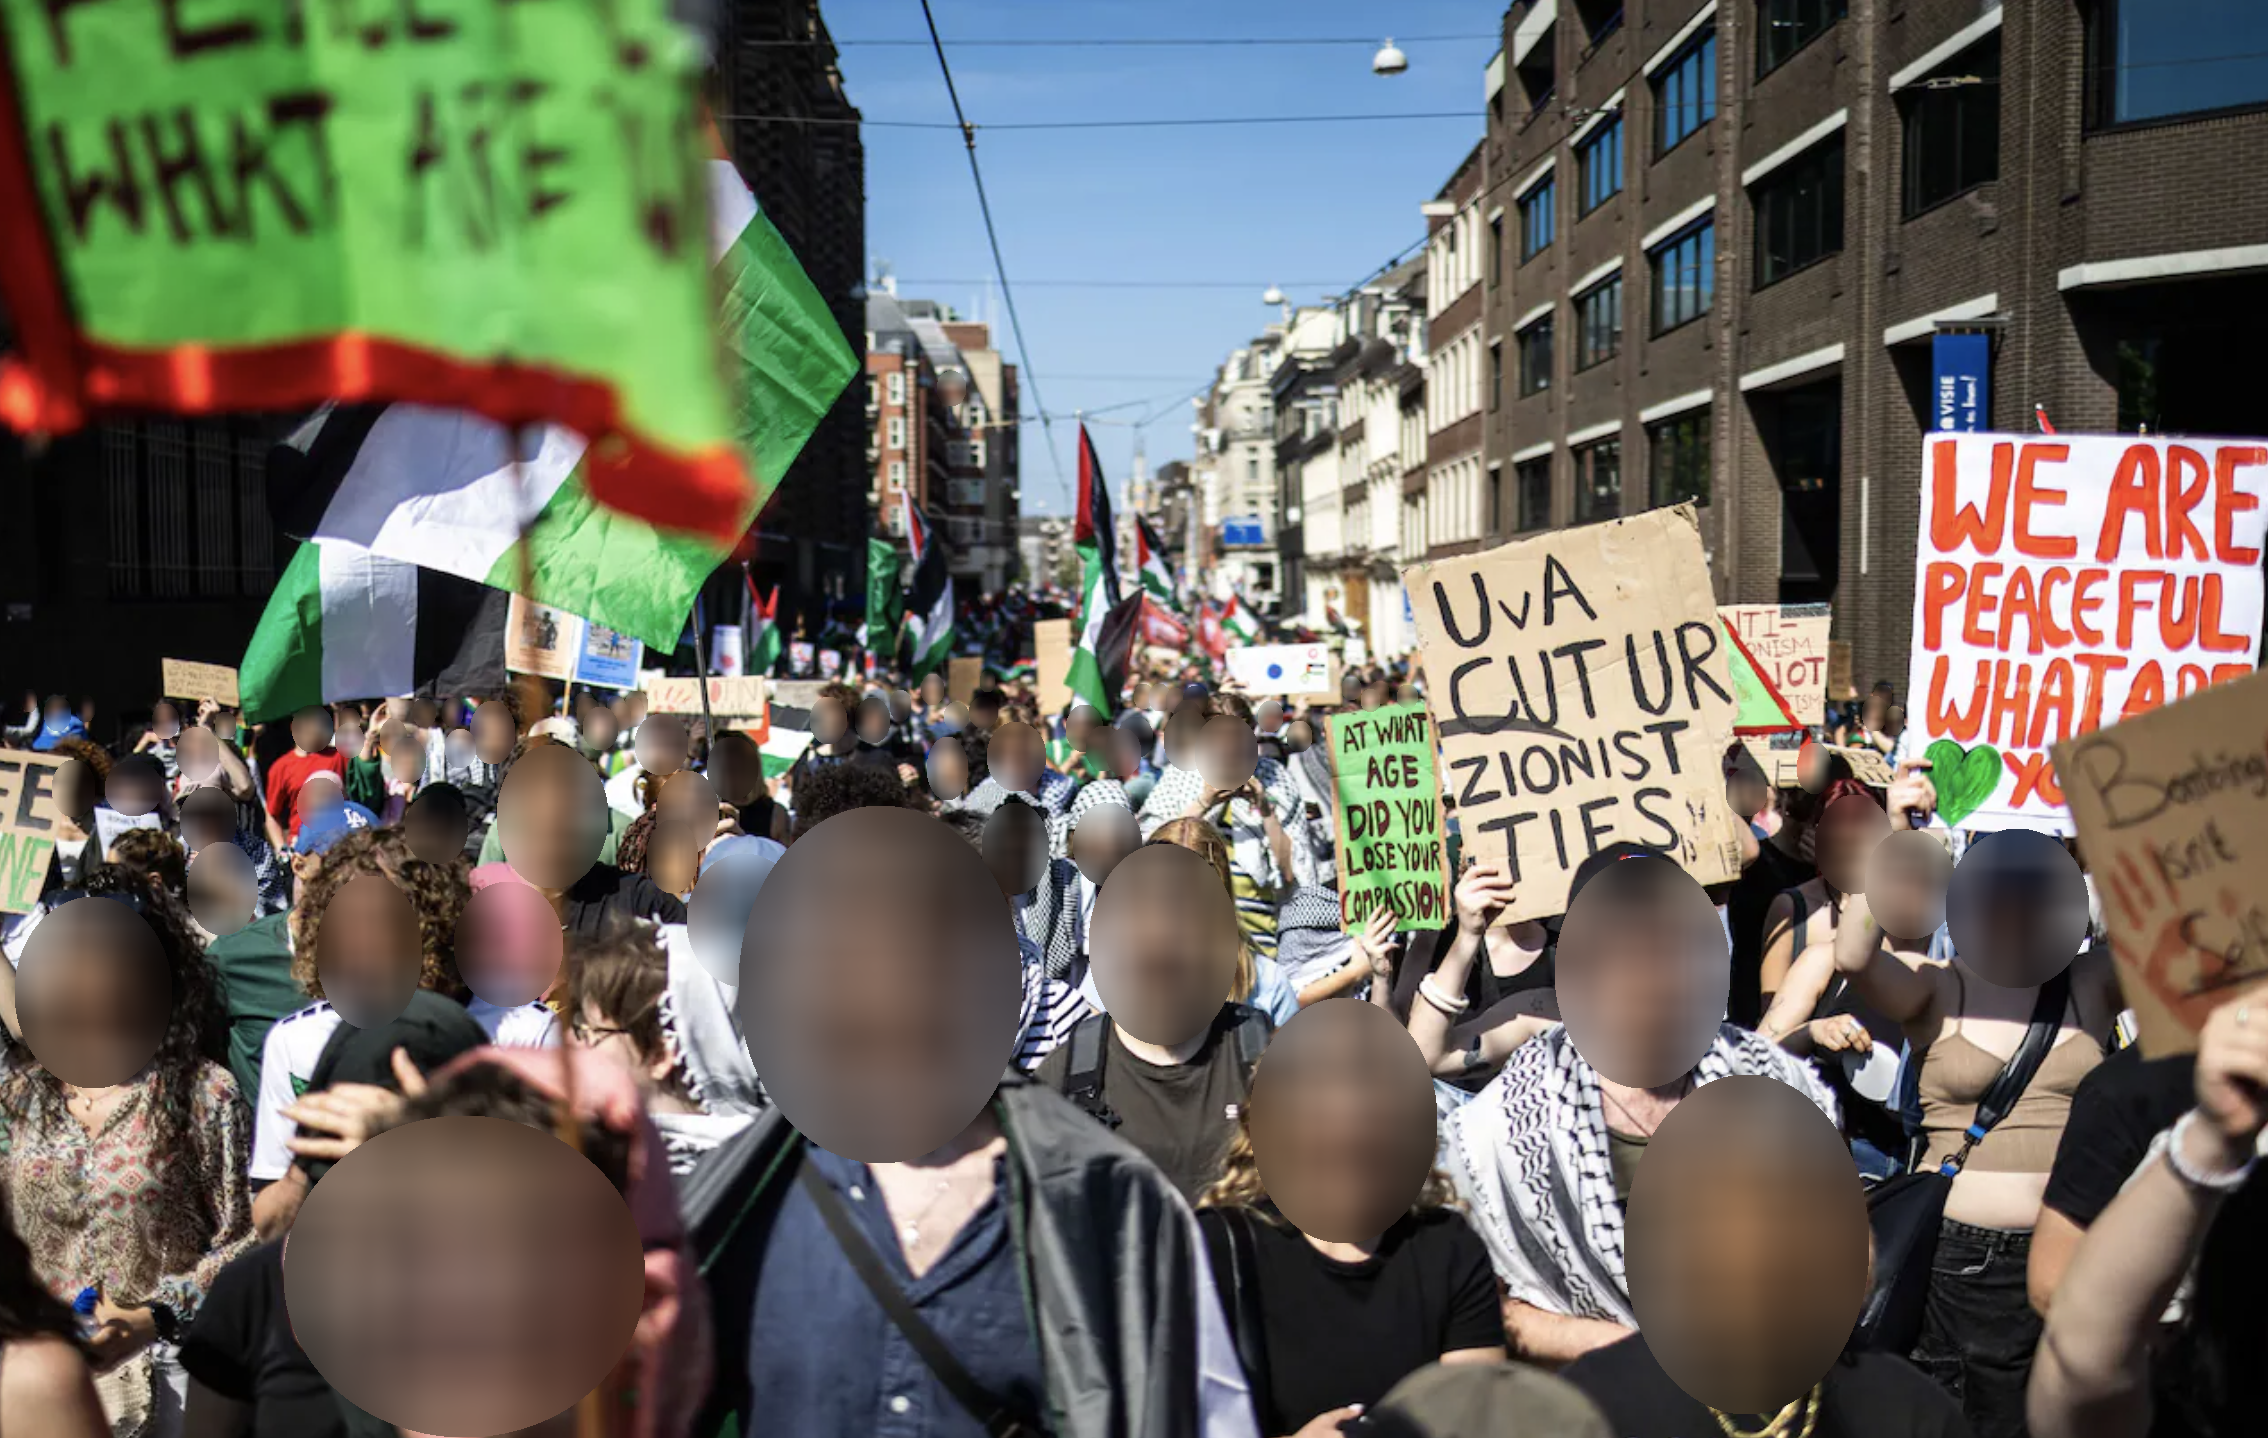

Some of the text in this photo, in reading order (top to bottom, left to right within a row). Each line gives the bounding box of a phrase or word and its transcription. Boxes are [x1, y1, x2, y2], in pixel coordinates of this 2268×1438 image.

[1930, 440, 2268, 566] WE ARE
[1433, 553, 1598, 648] UvA
[1923, 561, 2251, 655] PEACEFUL
[1449, 638, 1607, 734] CUT
[1625, 620, 1733, 716] UR
[1926, 650, 2129, 749] WHAT
[1343, 712, 1428, 753] AT WHAT
[1366, 754, 1419, 789] AGE
[1450, 719, 1690, 807] ZIONIST
[1345, 840, 1441, 877] LOSE YOUR
[1346, 797, 1436, 842] DID YOU
[1477, 787, 1681, 884] TIES
[1340, 879, 1445, 926] COMPASSION
